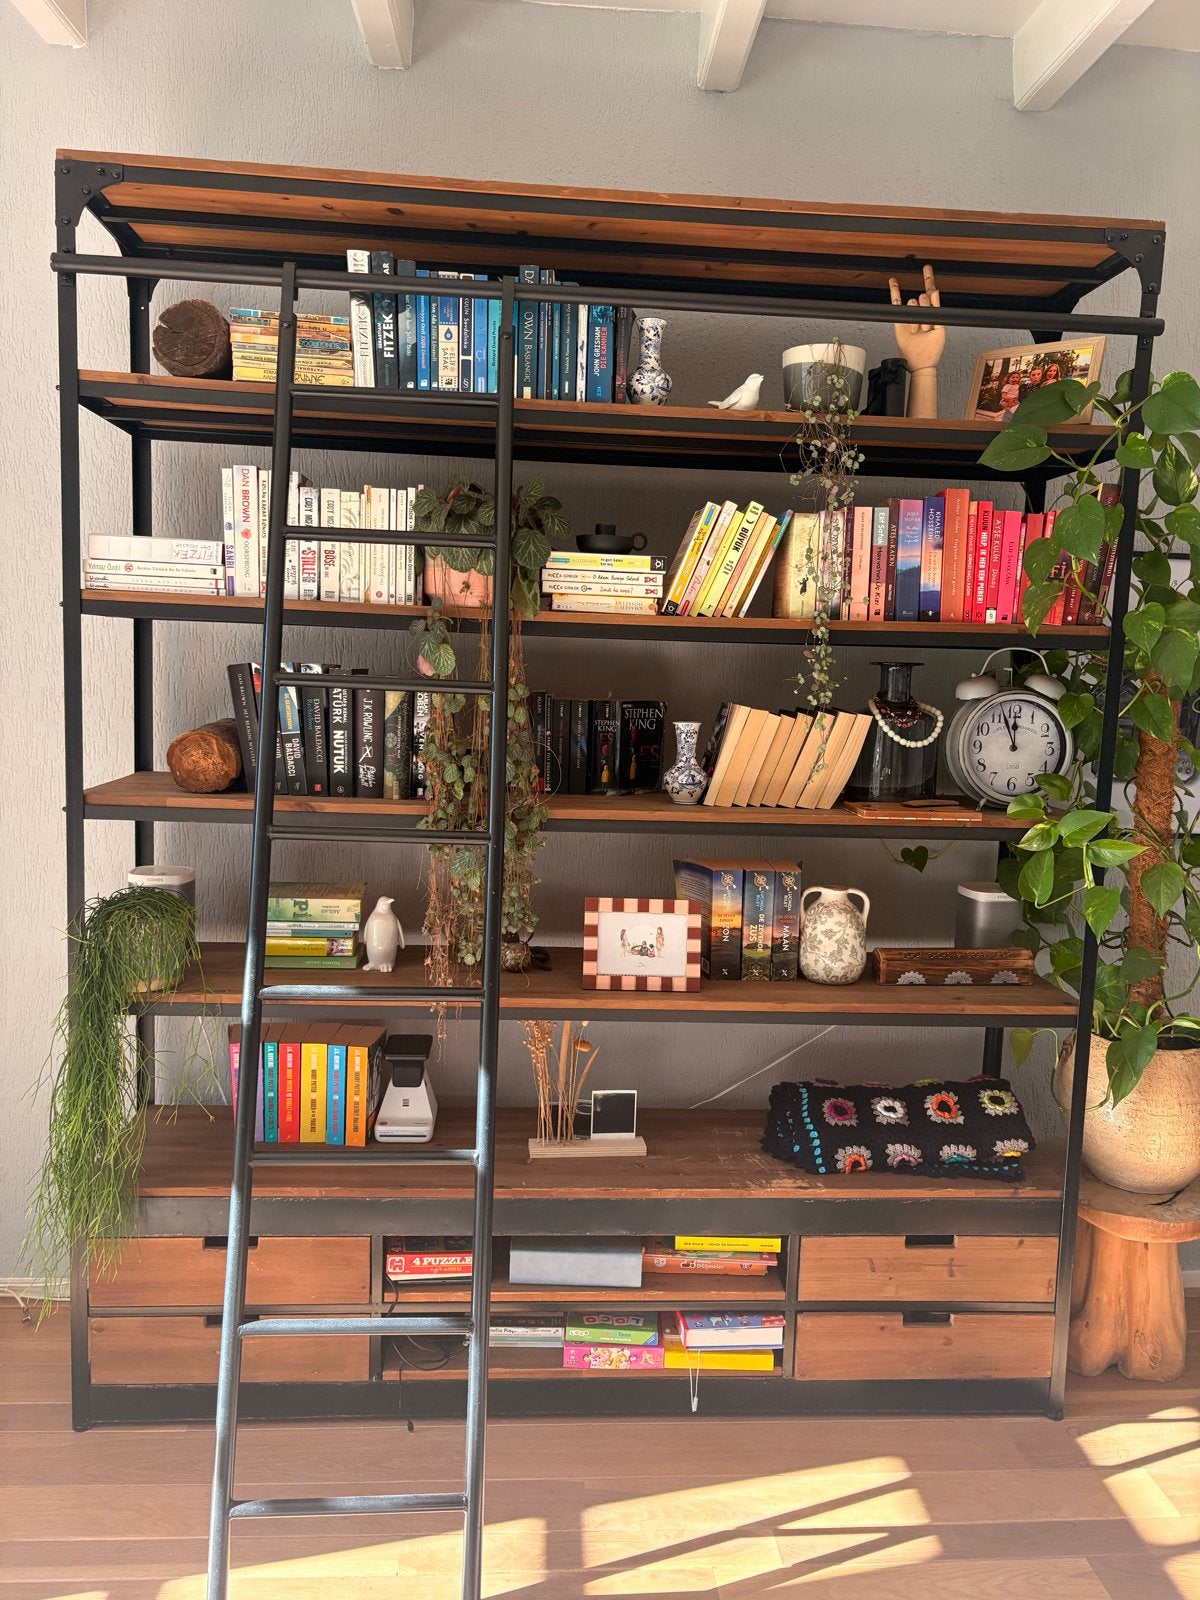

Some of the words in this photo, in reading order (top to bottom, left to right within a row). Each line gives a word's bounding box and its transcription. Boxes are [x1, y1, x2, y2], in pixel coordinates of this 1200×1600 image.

[382, 313, 394, 358] FITZEK
[242, 468, 250, 486] DAN
[242, 489, 250, 523] BROWN
[982, 510, 990, 530] KLUUN
[993, 519, 1002, 538] AYŞE
[732, 526, 749, 553] BÜYÜK
[979, 532, 988, 548] HELP,
[172, 549, 213, 560] FITZEK
[226, 544, 234, 568] SANRI
[324, 549, 337, 568] BÖSE
[992, 540, 1000, 562] KULİN
[363, 698, 373, 712] J.K.
[1008, 704, 1022, 719] 12
[624, 708, 664, 719] STEPHEN
[363, 712, 373, 742] ROWLING
[630, 718, 656, 730] KING
[976, 722, 990, 736] 10
[1040, 723, 1050, 738] 2
[292, 738, 301, 758] DAVID
[315, 726, 323, 763] BALDACCI
[334, 730, 344, 774] NUTUK
[972, 739, 983, 754] 9
[1044, 742, 1055, 756] 3
[285, 743, 296, 776] BALDACCI
[976, 758, 987, 772] 8
[1039, 760, 1049, 773] 4
[989, 772, 999, 786] 7
[1007, 776, 1016, 791] 6
[1025, 773, 1035, 786] 5
[758, 914, 765, 922] DE
[412, 1257, 420, 1265] 4
[585, 1316, 640, 1325] LOCO
